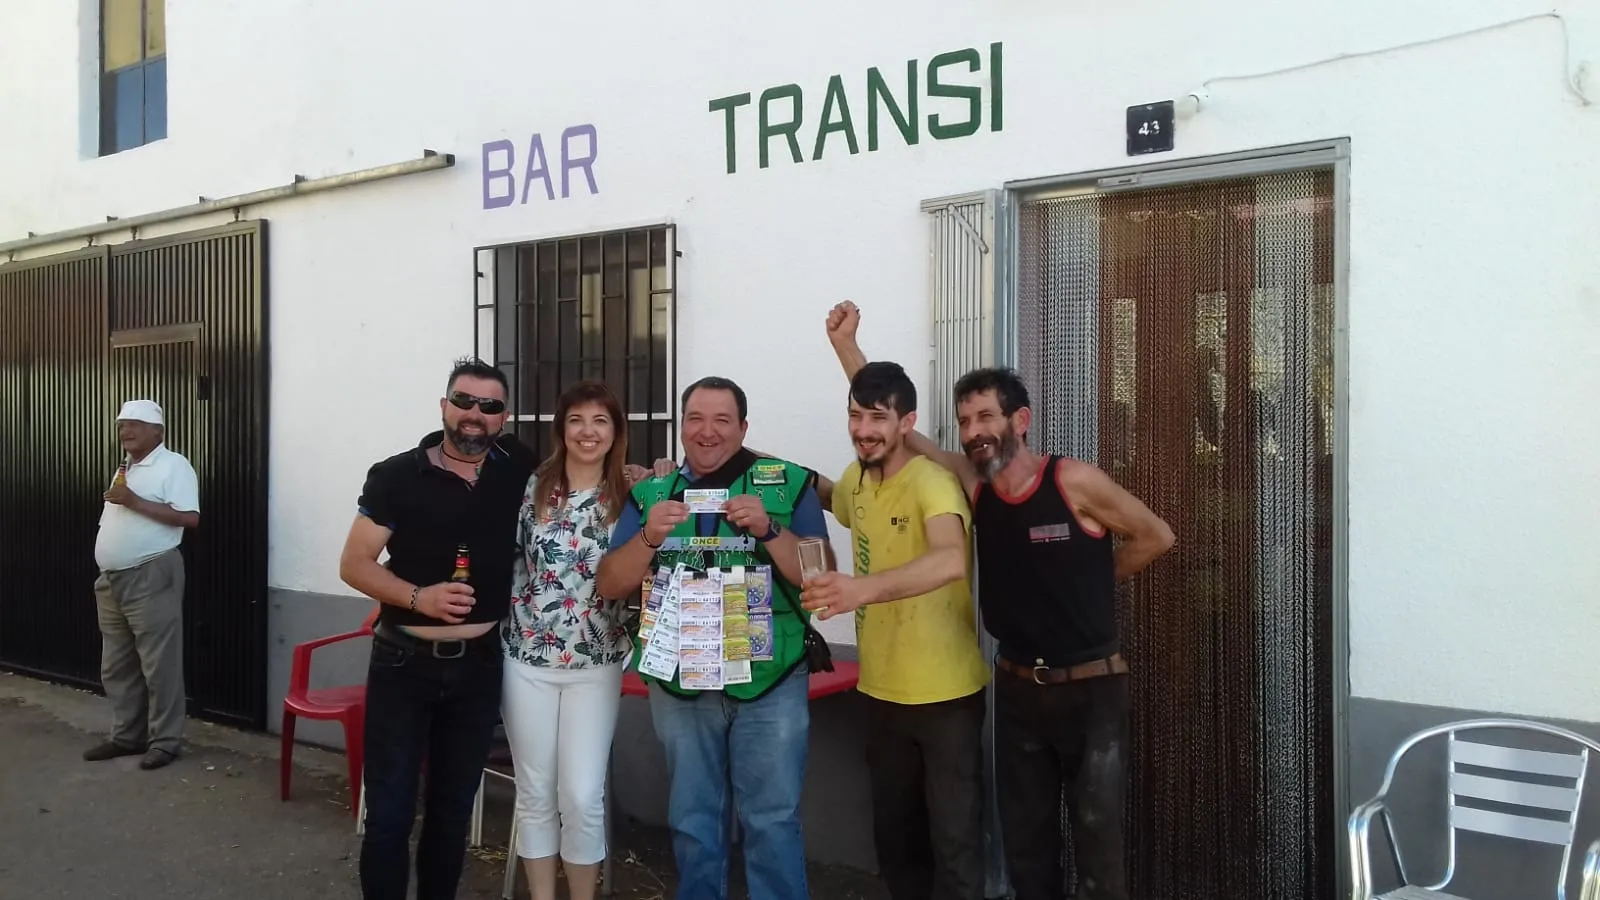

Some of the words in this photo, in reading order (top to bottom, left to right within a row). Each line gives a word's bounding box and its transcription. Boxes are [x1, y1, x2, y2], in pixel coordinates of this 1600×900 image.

[482, 123, 599, 210] BAR
[709, 41, 1004, 174] TRANSI
[1138, 120, 1160, 136] 43
